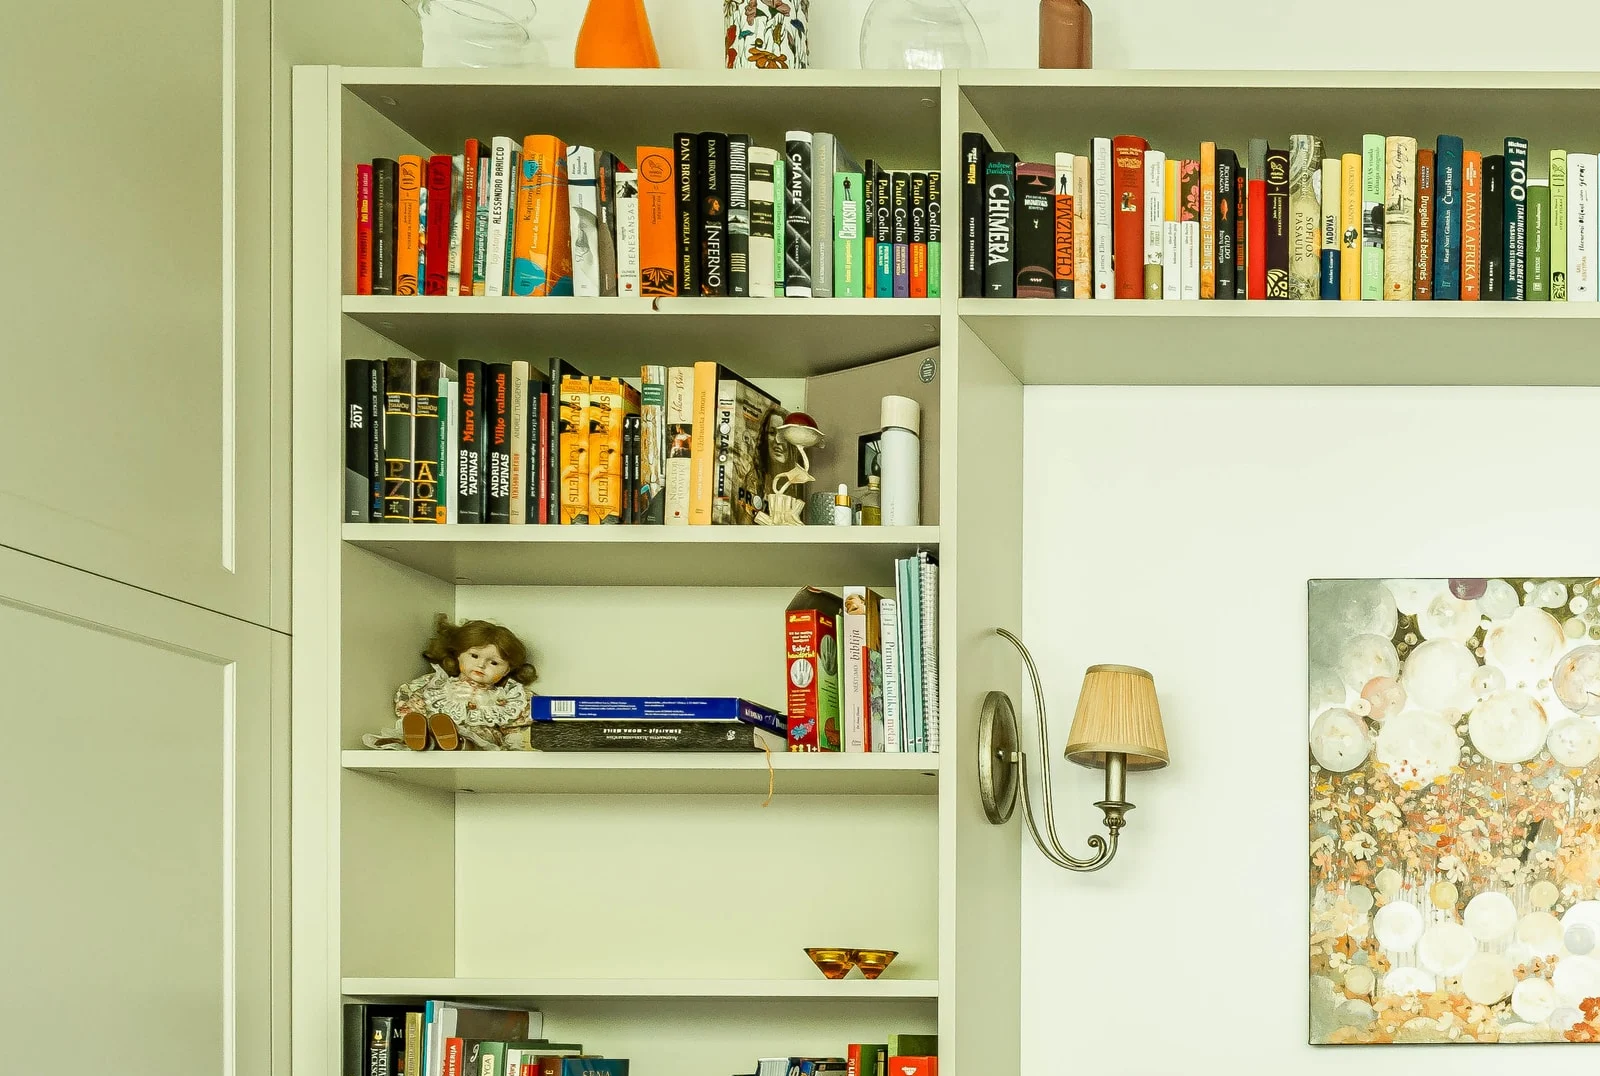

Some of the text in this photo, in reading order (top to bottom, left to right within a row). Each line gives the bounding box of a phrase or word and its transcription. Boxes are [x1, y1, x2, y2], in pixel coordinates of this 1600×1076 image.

[495, 147, 504, 176] BARICCO
[681, 138, 690, 201] DAN BROWN
[708, 140, 716, 157] DAN
[730, 142, 746, 207] SANDRA BROWN
[792, 153, 802, 204] CHANEL
[929, 174, 939, 200] Paulo
[1510, 159, 1525, 200] 100
[493, 179, 503, 224] ALESSANDRO
[838, 200, 857, 239] Clarkson
[865, 199, 873, 223] Coelho
[878, 179, 889, 241] Paulo Coelho
[895, 180, 906, 242] Paulo Coelho
[913, 179, 924, 241] Paulo Coelho
[929, 202, 940, 241] Coelho
[988, 184, 1009, 265] CHIMERA
[628, 203, 636, 265] RENESANSAS
[1057, 197, 1072, 276] CHARIZMA
[1295, 212, 1303, 262] PASAULIS
[1305, 216, 1313, 258] SOFIJOS
[1326, 215, 1334, 245] VADOVAS
[1419, 196, 1431, 280] Drugeliai bedugnės
[1465, 192, 1476, 280] MAMA AFRIKA
[705, 225, 722, 287] INFERNO
[353, 404, 363, 428] 2017
[463, 409, 475, 442] Maro
[495, 373, 506, 444] Vilko valanda
[460, 449, 468, 496] ANDRIUS
[469, 452, 478, 495] TAPINAS
[491, 452, 500, 498] ANDRIUS
[500, 454, 509, 497] TAPINAS
[849, 629, 863, 661] biblija
